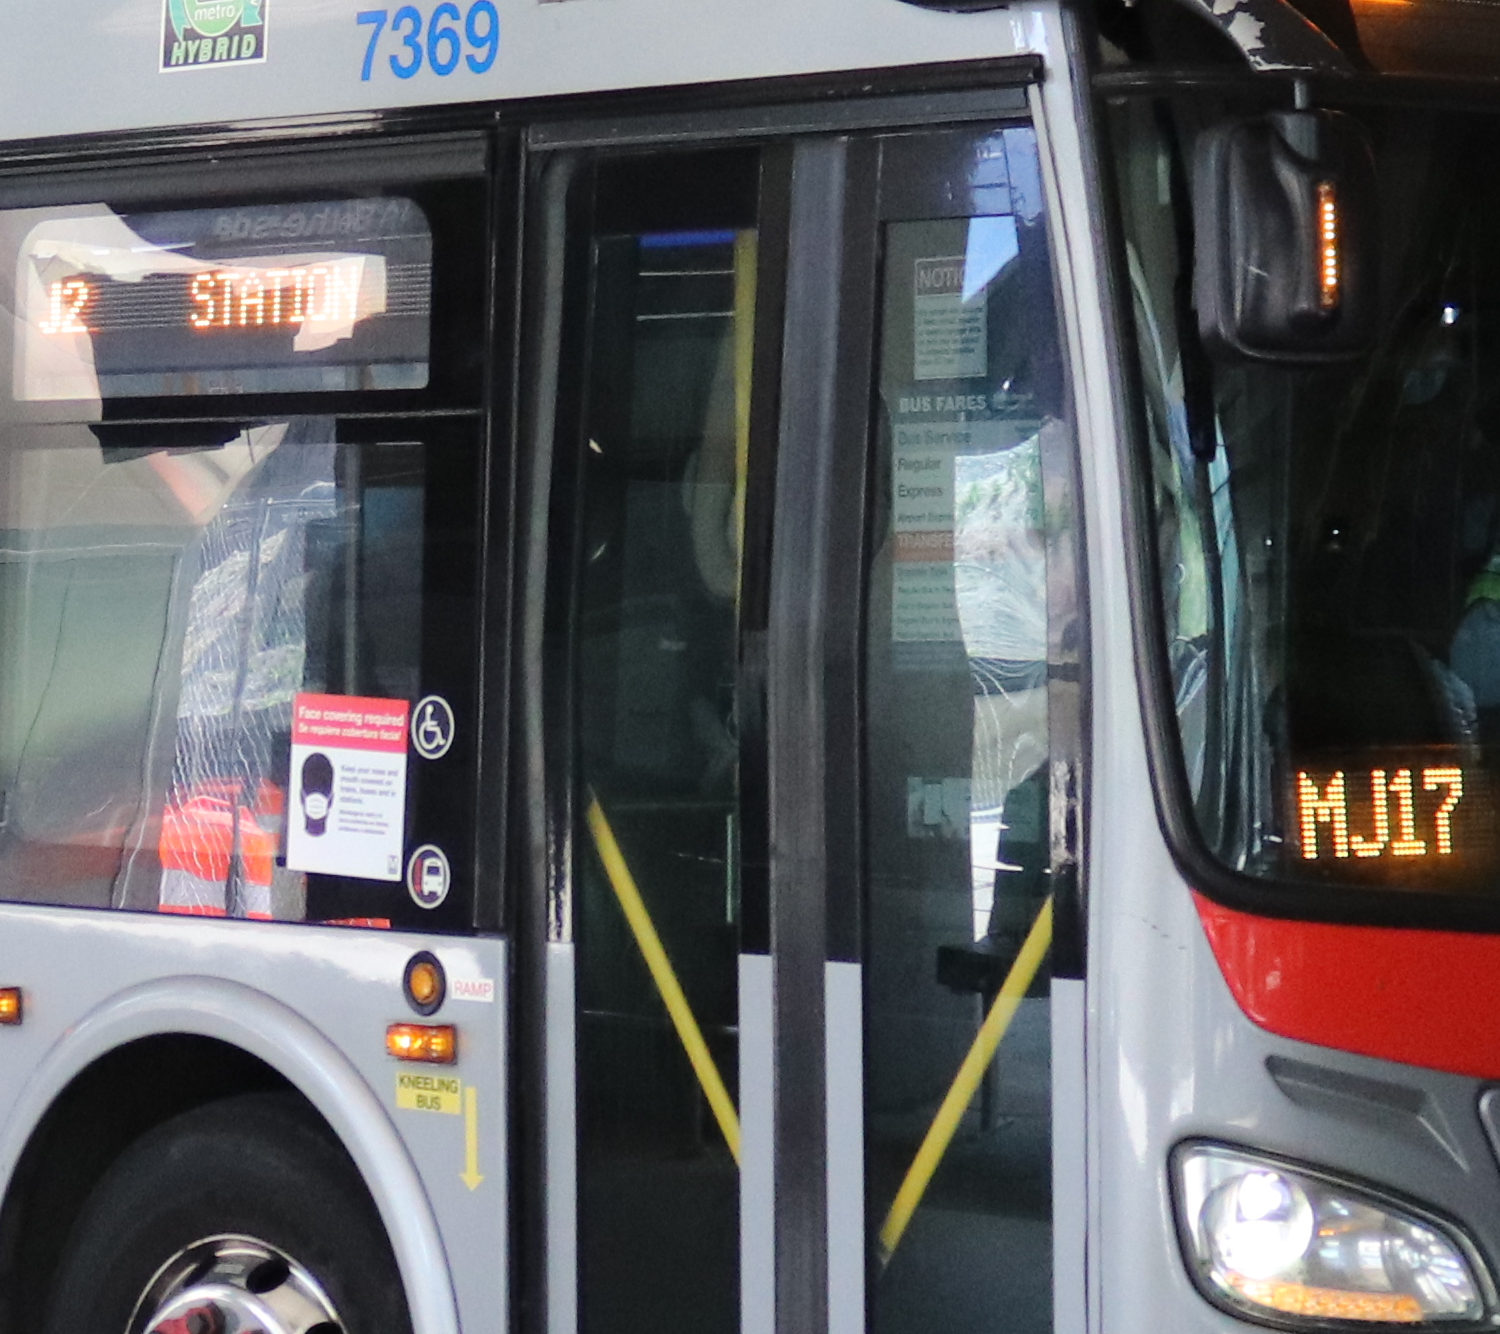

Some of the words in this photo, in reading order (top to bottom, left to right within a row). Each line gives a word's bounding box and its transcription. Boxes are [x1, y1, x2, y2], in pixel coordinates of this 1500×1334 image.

[194, 3, 236, 22] metro
[170, 34, 257, 66] HYBRID
[356, 0, 500, 82] 7369
[919, 267, 964, 289] NOTI
[189, 266, 360, 330] STATION
[899, 396, 931, 413] BUS
[936, 395, 987, 412] FARES
[298, 705, 322, 720] Face
[323, 710, 363, 727] covering
[364, 713, 405, 728] required
[1297, 765, 1466, 861] MJ17
[454, 980, 492, 997] RAMP
[399, 1074, 459, 1094] KNEELING
[416, 1094, 442, 1111] BUS
